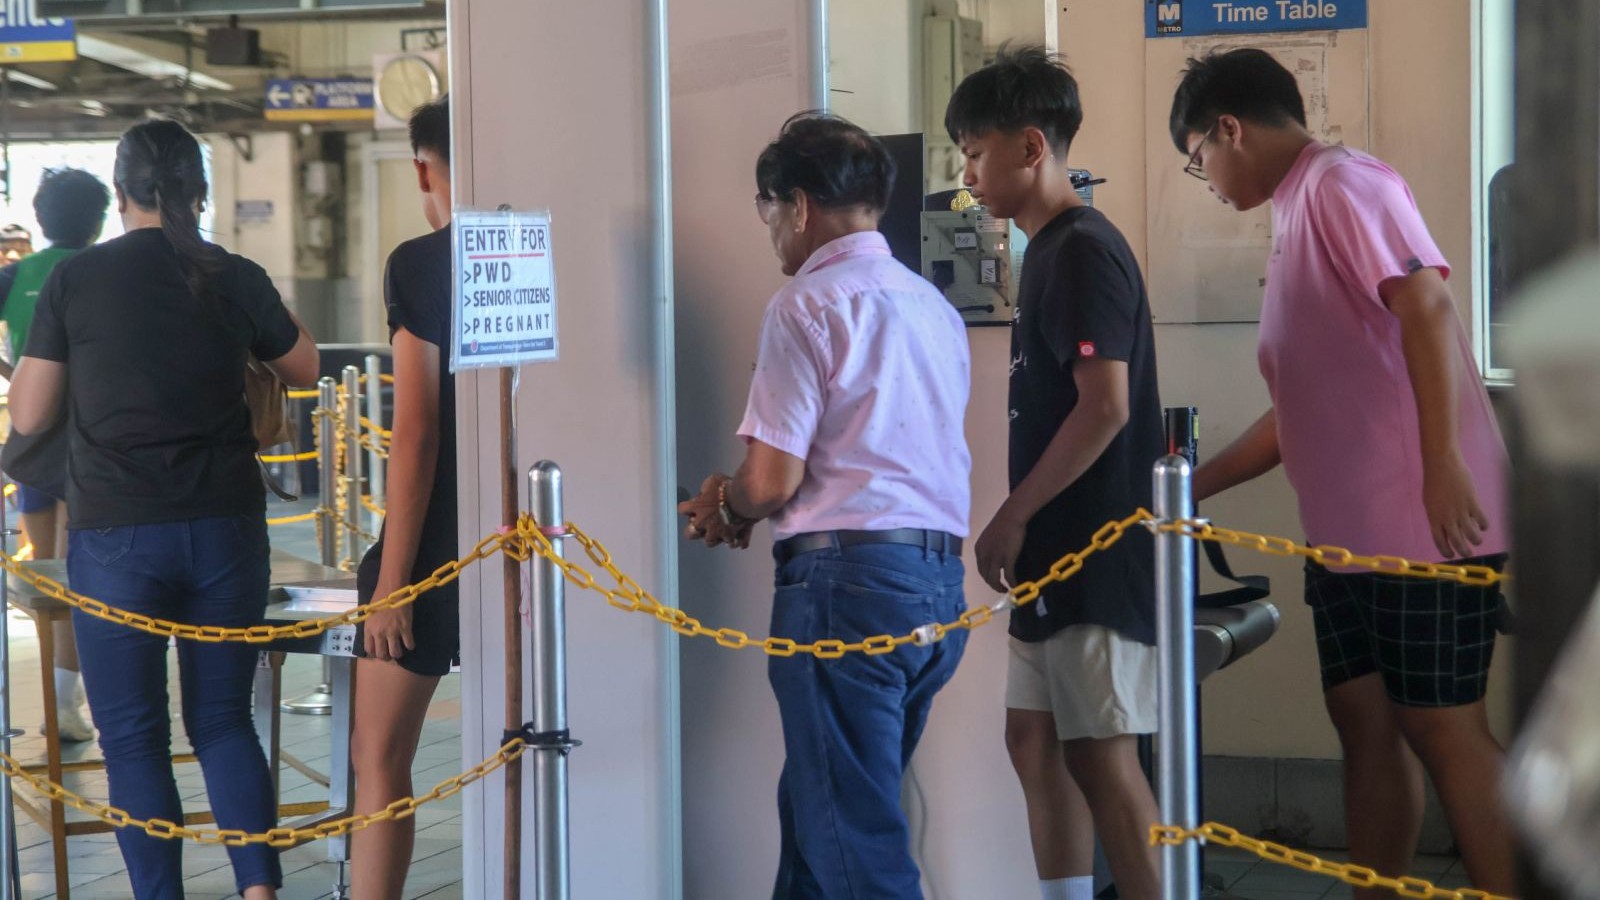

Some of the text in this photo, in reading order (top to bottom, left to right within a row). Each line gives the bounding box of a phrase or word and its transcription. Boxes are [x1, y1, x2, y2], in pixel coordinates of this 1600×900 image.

[1212, 0, 1337, 23] Time Table
[464, 228, 546, 252] ENTRY FOR
[514, 287, 550, 305] CITIZENS
